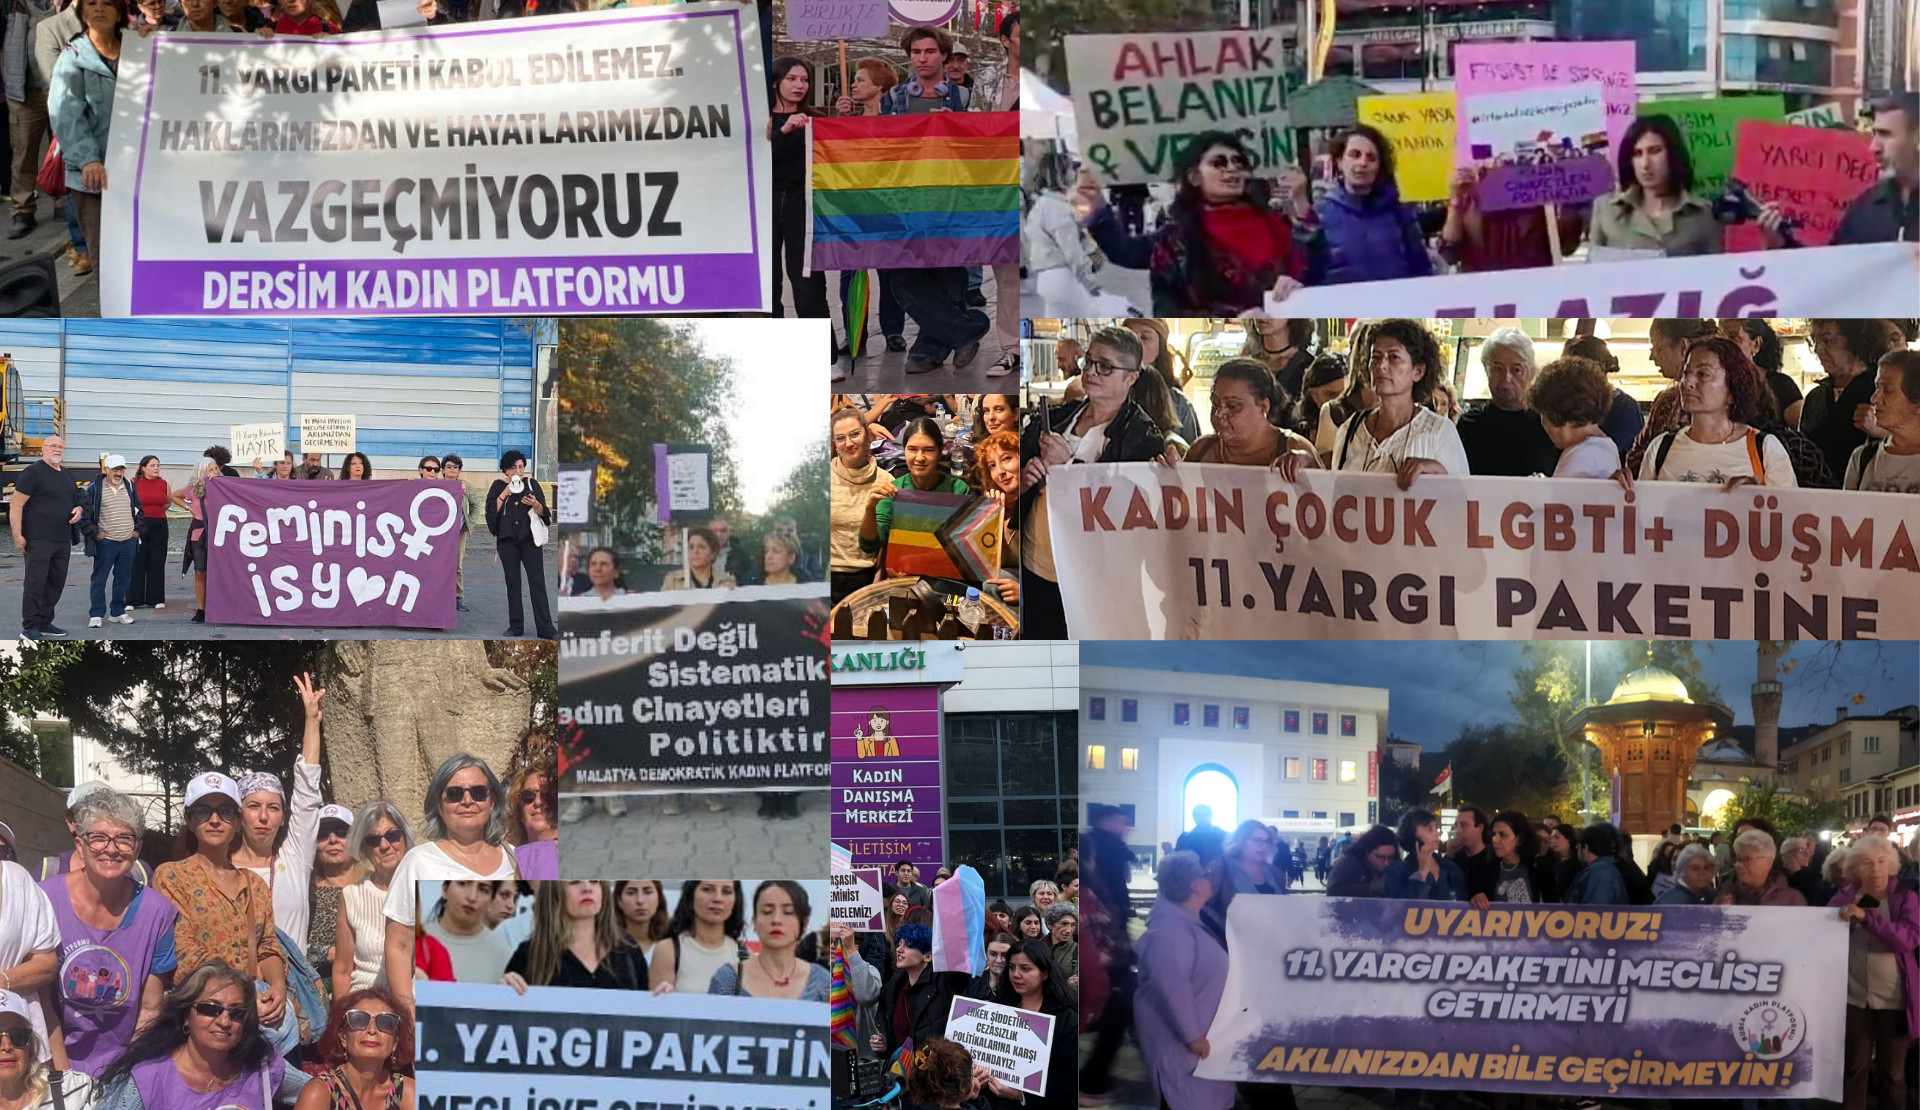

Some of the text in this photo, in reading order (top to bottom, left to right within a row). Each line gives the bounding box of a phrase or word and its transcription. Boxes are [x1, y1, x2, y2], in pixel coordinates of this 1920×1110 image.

[198, 42, 684, 95] 11. YARGI PAKETİ KABUL EDİLEMEZ.
[1114, 36, 1274, 81] AHLAK
[160, 103, 731, 152] HAKLARIMIZDAN VE HAYATLARIMIZDAN
[198, 163, 683, 254] VAZGEÇMİYORUZ
[202, 263, 684, 310] DERSİM KADIN PLATFORMU
[236, 438, 279, 457] HAYIR
[1079, 486, 1920, 582] KADIN ÇOCUK LGBTİ+ DÜŞMA
[1496, 572, 1880, 640] PAKETİNE
[674, 621, 758, 657] Değil
[648, 656, 827, 687] Sistematik
[650, 727, 826, 757] Politiktir
[576, 768, 637, 784] MALATYA
[729, 764, 771, 779] KADIN
[853, 769, 903, 784] KADIN
[843, 788, 915, 807] DANIŞMA
[845, 804, 914, 824] MERKEZİ
[1403, 908, 1663, 941] UYARIYORUZ!
[1284, 946, 1782, 993] 11. YARGI PAKETİNİ MECLİSE
[966, 1006, 989, 1020] ERKEK
[1427, 985, 1629, 1023] GETİRMEYİ
[1743, 1000, 1769, 1016] KADIN
[1771, 1000, 1797, 1041] PLATFORMU
[456, 1023, 609, 1069] YARGI
[976, 1022, 1018, 1042] CEZASIZLIK
[1013, 1045, 1037, 1063] KARŞI
[1256, 1045, 1475, 1080] AKLINIZDAN
[1480, 1044, 1554, 1083] BİLE
